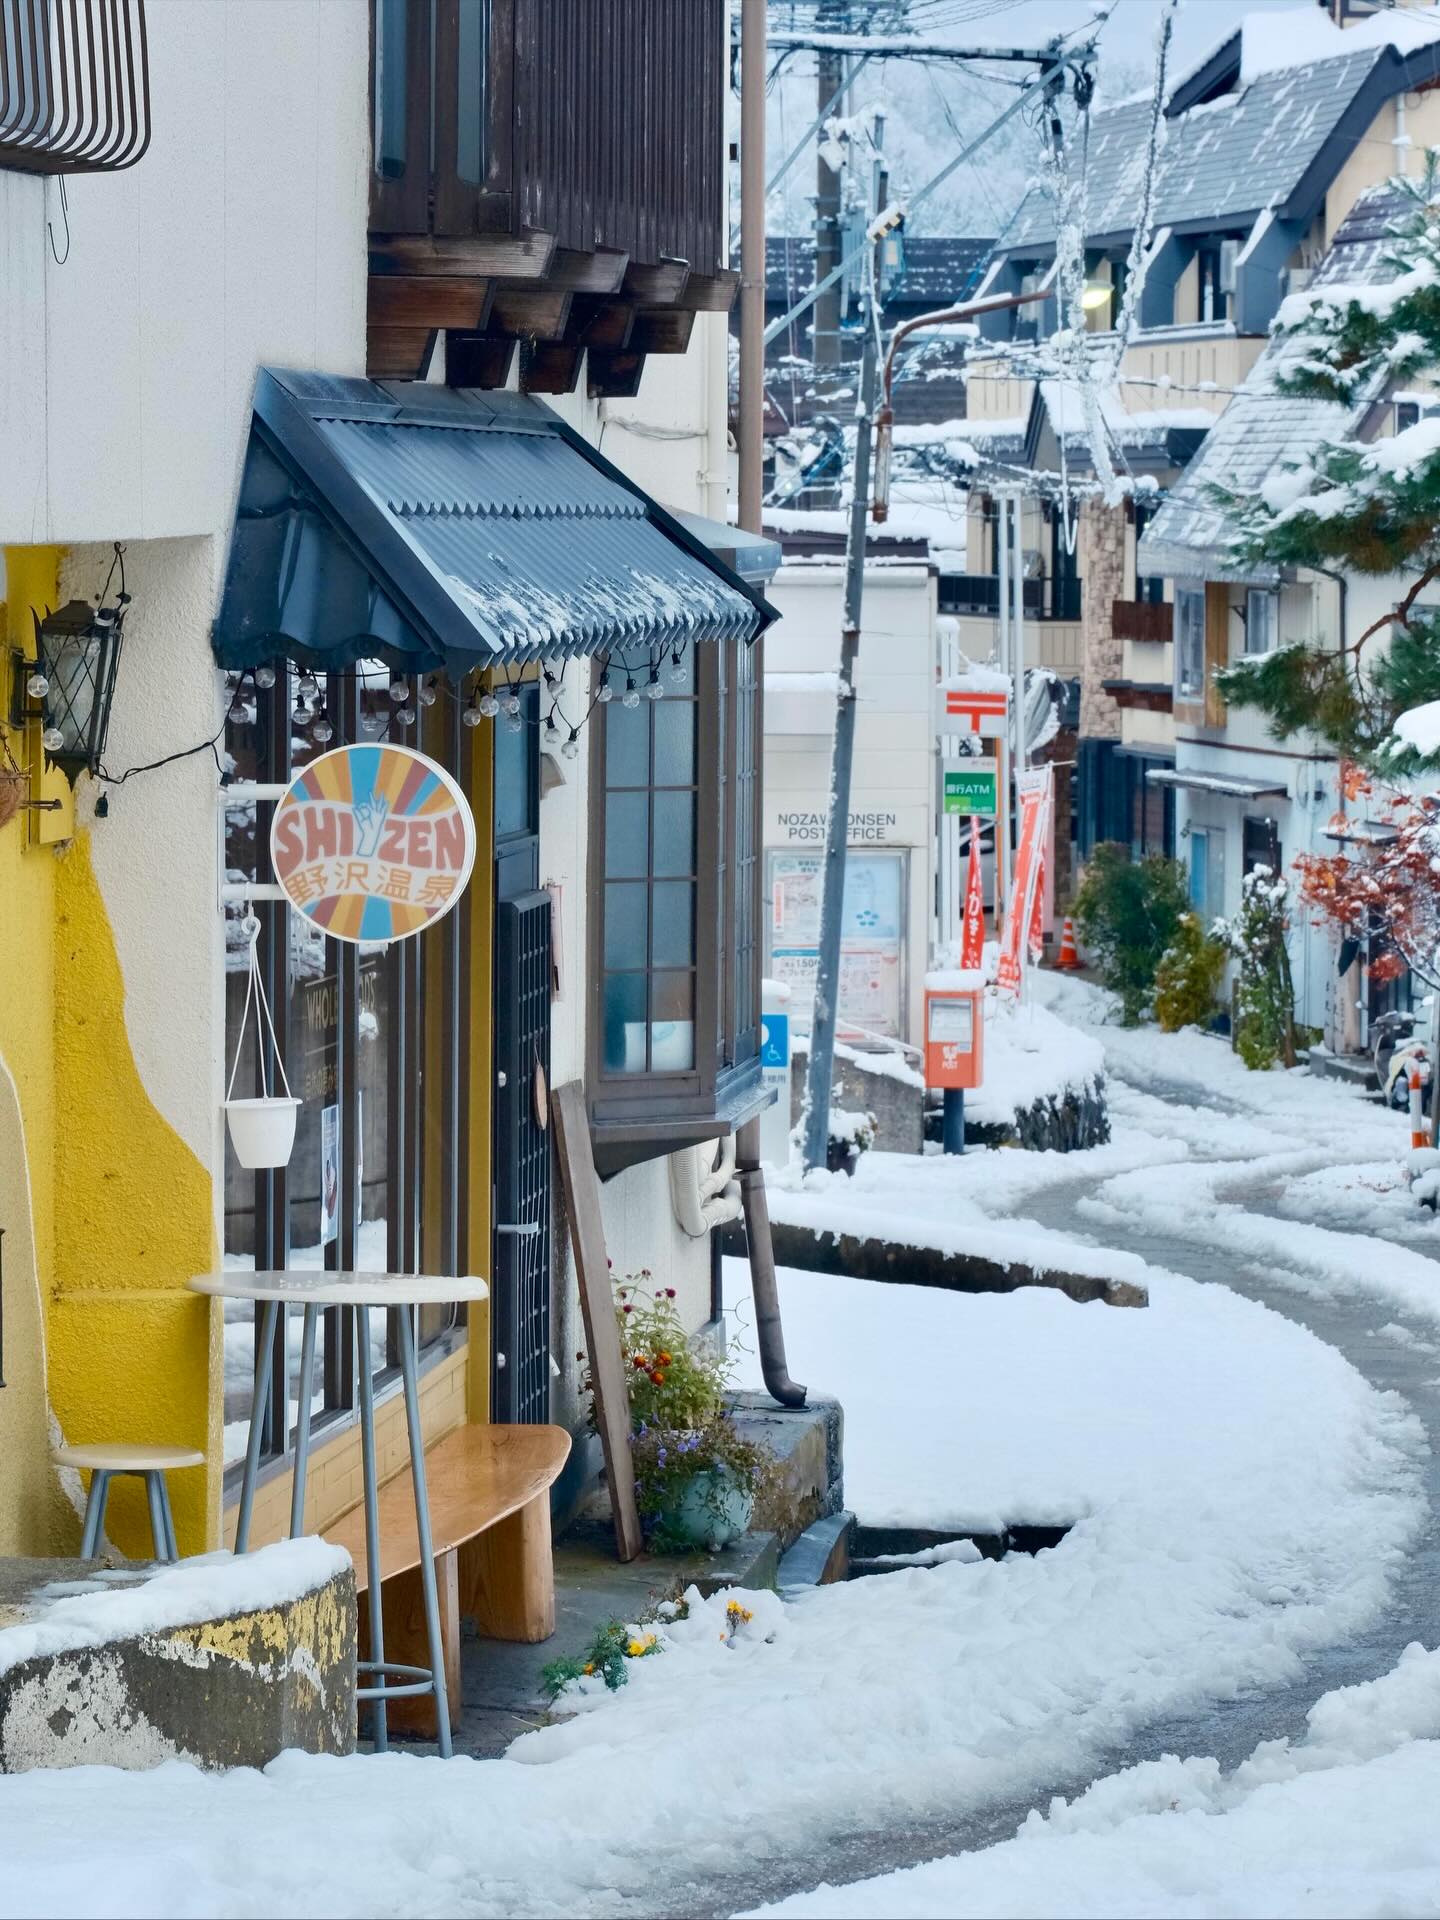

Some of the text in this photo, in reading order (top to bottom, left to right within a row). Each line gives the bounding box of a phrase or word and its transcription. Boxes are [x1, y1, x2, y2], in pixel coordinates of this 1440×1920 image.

[778, 813, 827, 825] NOZA
[282, 861, 458, 909] 野沢温泉
